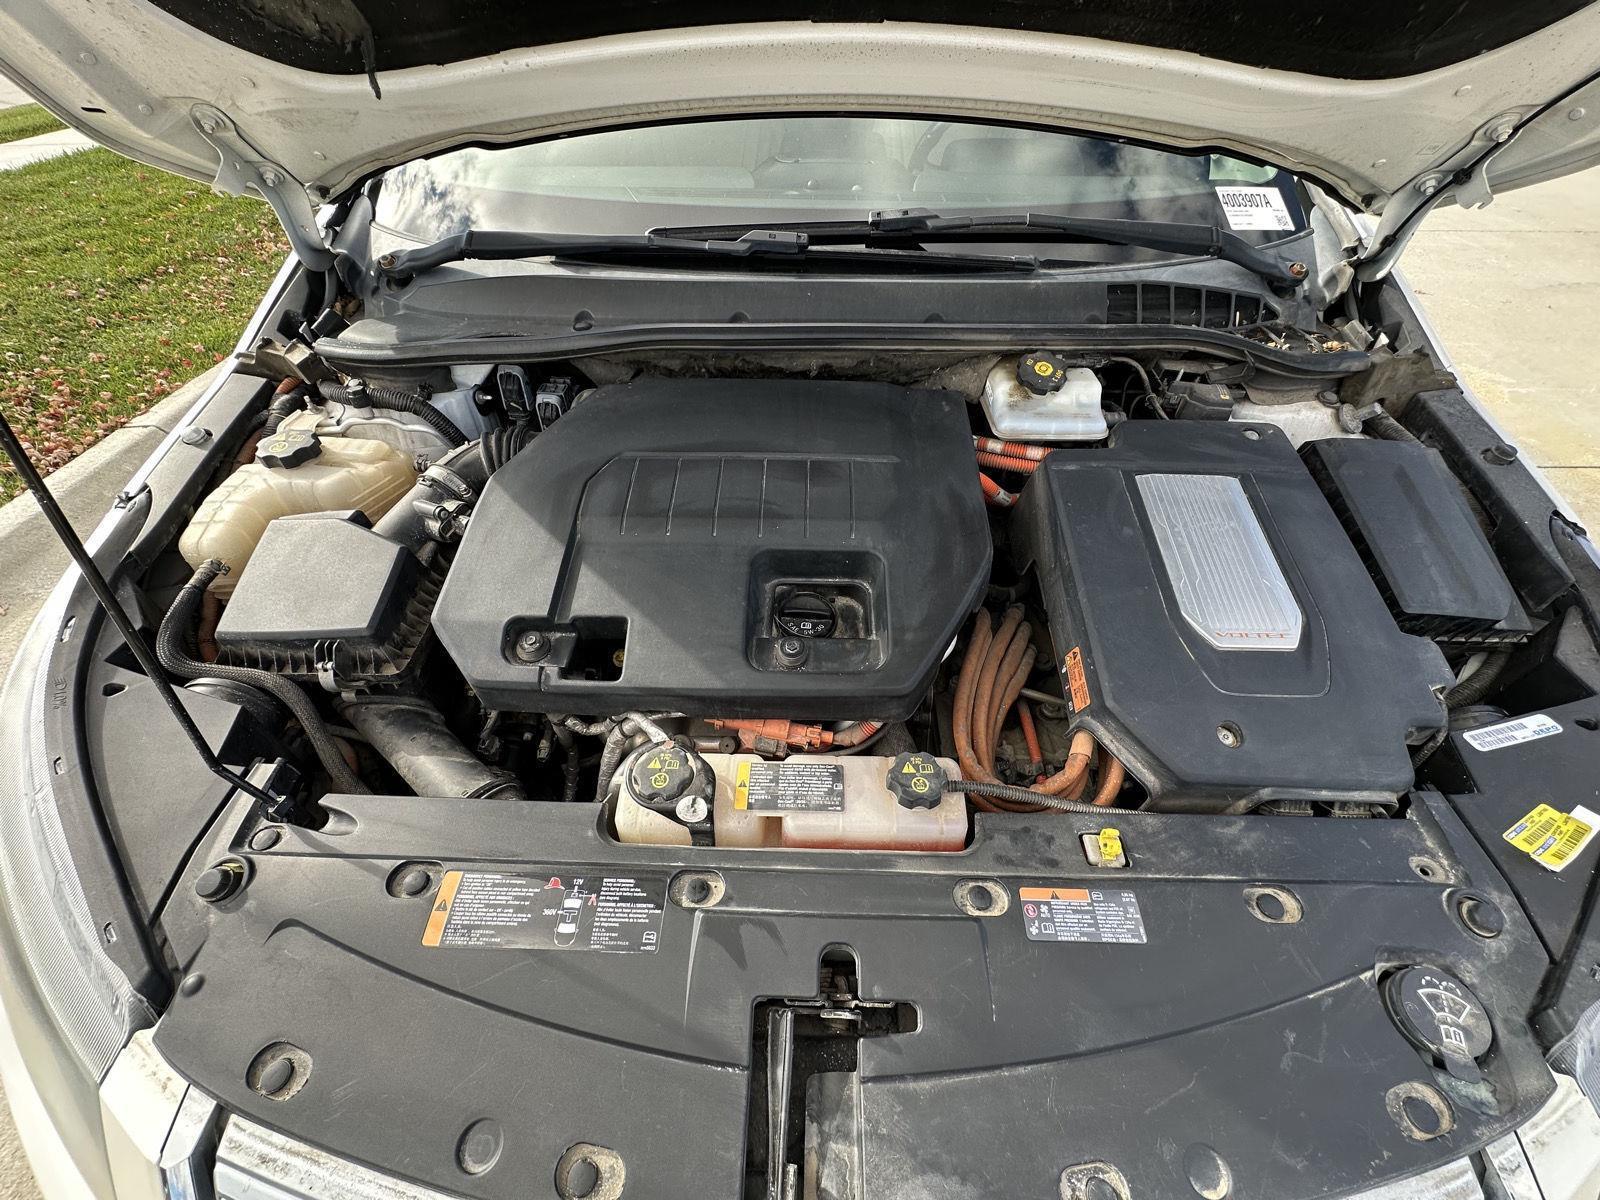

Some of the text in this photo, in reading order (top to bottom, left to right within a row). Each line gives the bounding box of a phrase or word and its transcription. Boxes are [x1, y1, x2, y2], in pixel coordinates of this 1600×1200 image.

[1221, 193, 1273, 208] 4003907A
[787, 622, 800, 633] SAE
[1215, 631, 1297, 639] VOLTEC
[1532, 725, 1559, 737] DEPO
[542, 908, 558, 916] 360V
